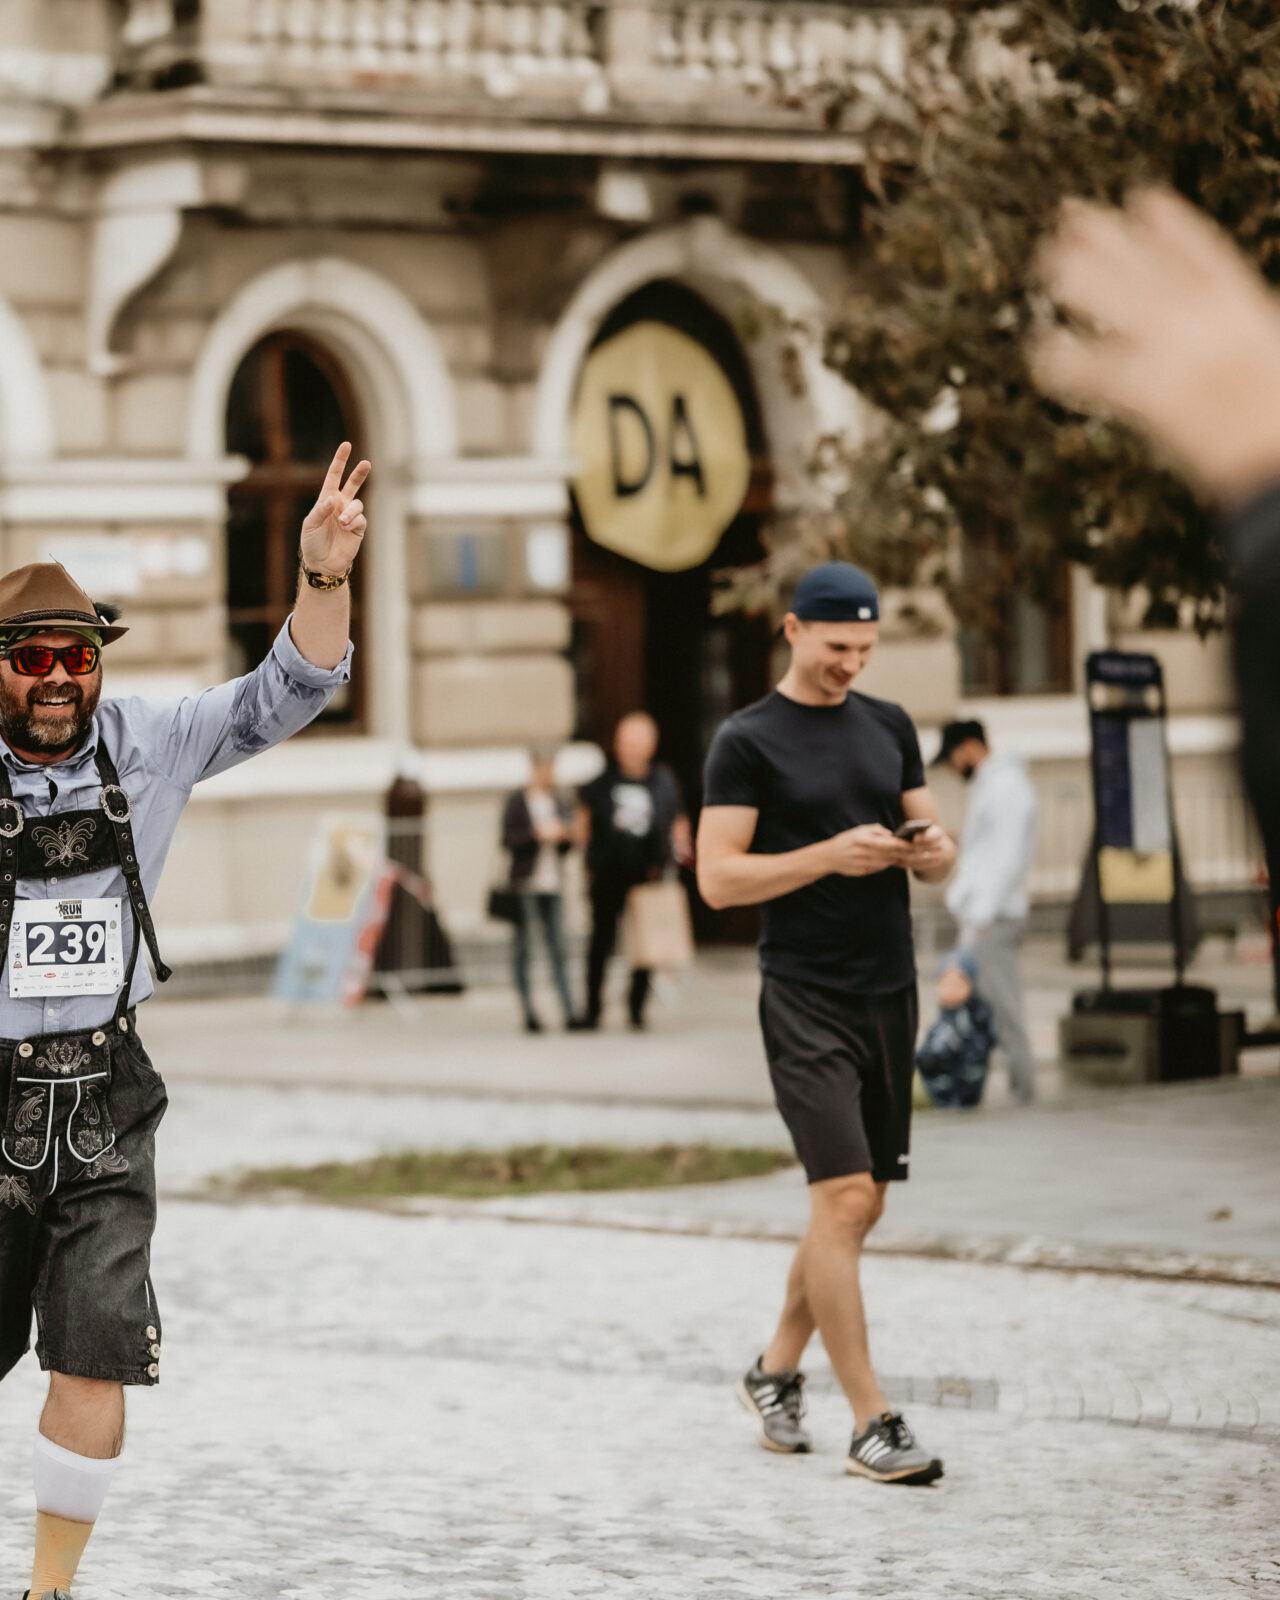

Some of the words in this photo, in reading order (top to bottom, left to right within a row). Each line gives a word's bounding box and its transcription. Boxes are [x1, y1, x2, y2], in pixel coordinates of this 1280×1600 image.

[609, 395, 707, 498] DA
[62, 904, 82, 915] RUN
[28, 923, 105, 963] 239
